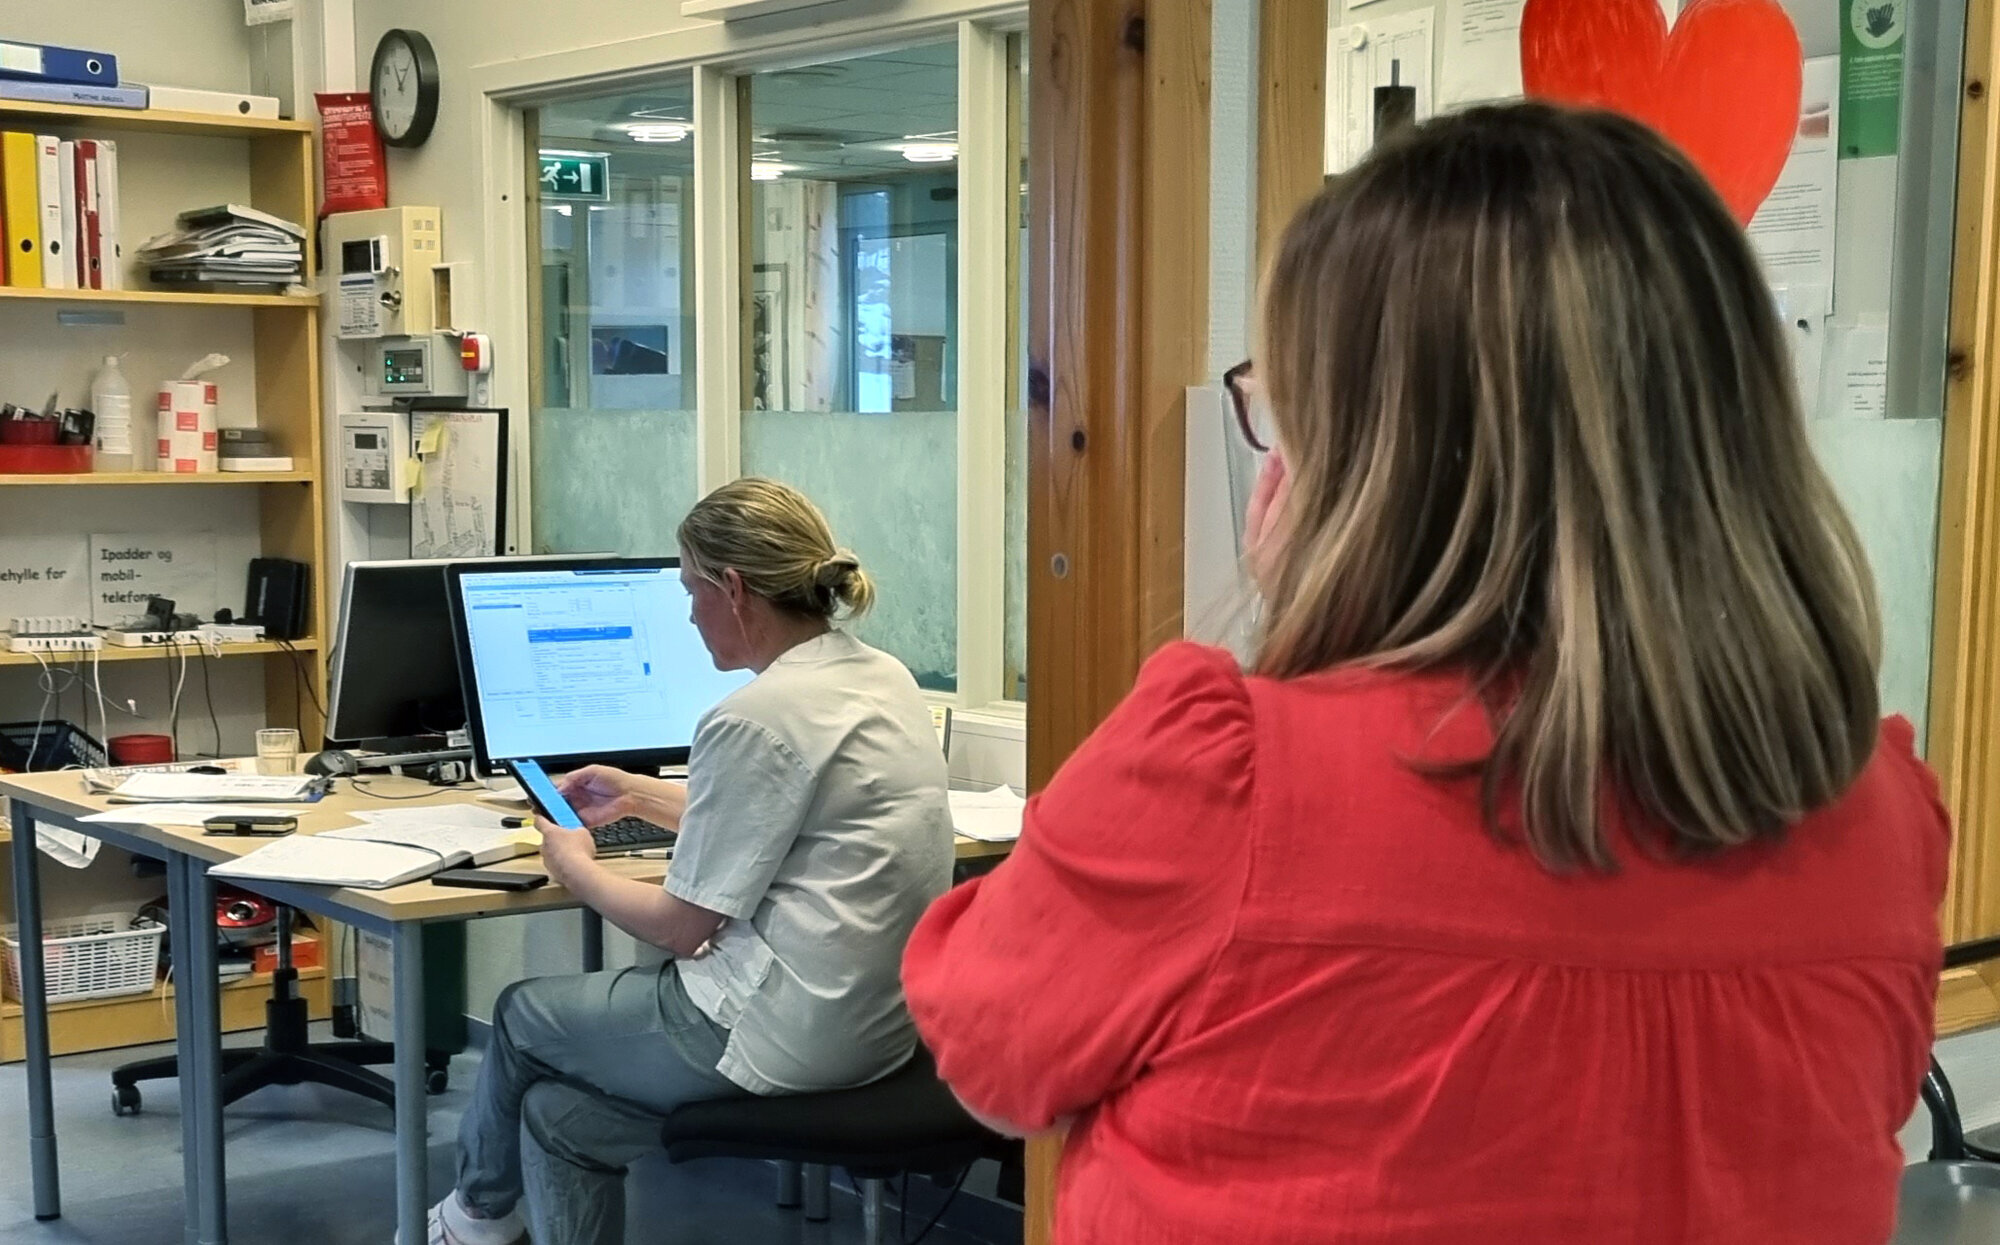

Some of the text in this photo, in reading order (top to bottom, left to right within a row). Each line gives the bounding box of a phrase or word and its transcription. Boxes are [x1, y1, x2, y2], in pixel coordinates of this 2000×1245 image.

[101, 548, 172, 563] Ipadder og
[46, 567, 66, 580] for
[101, 569, 142, 581] mobil-
